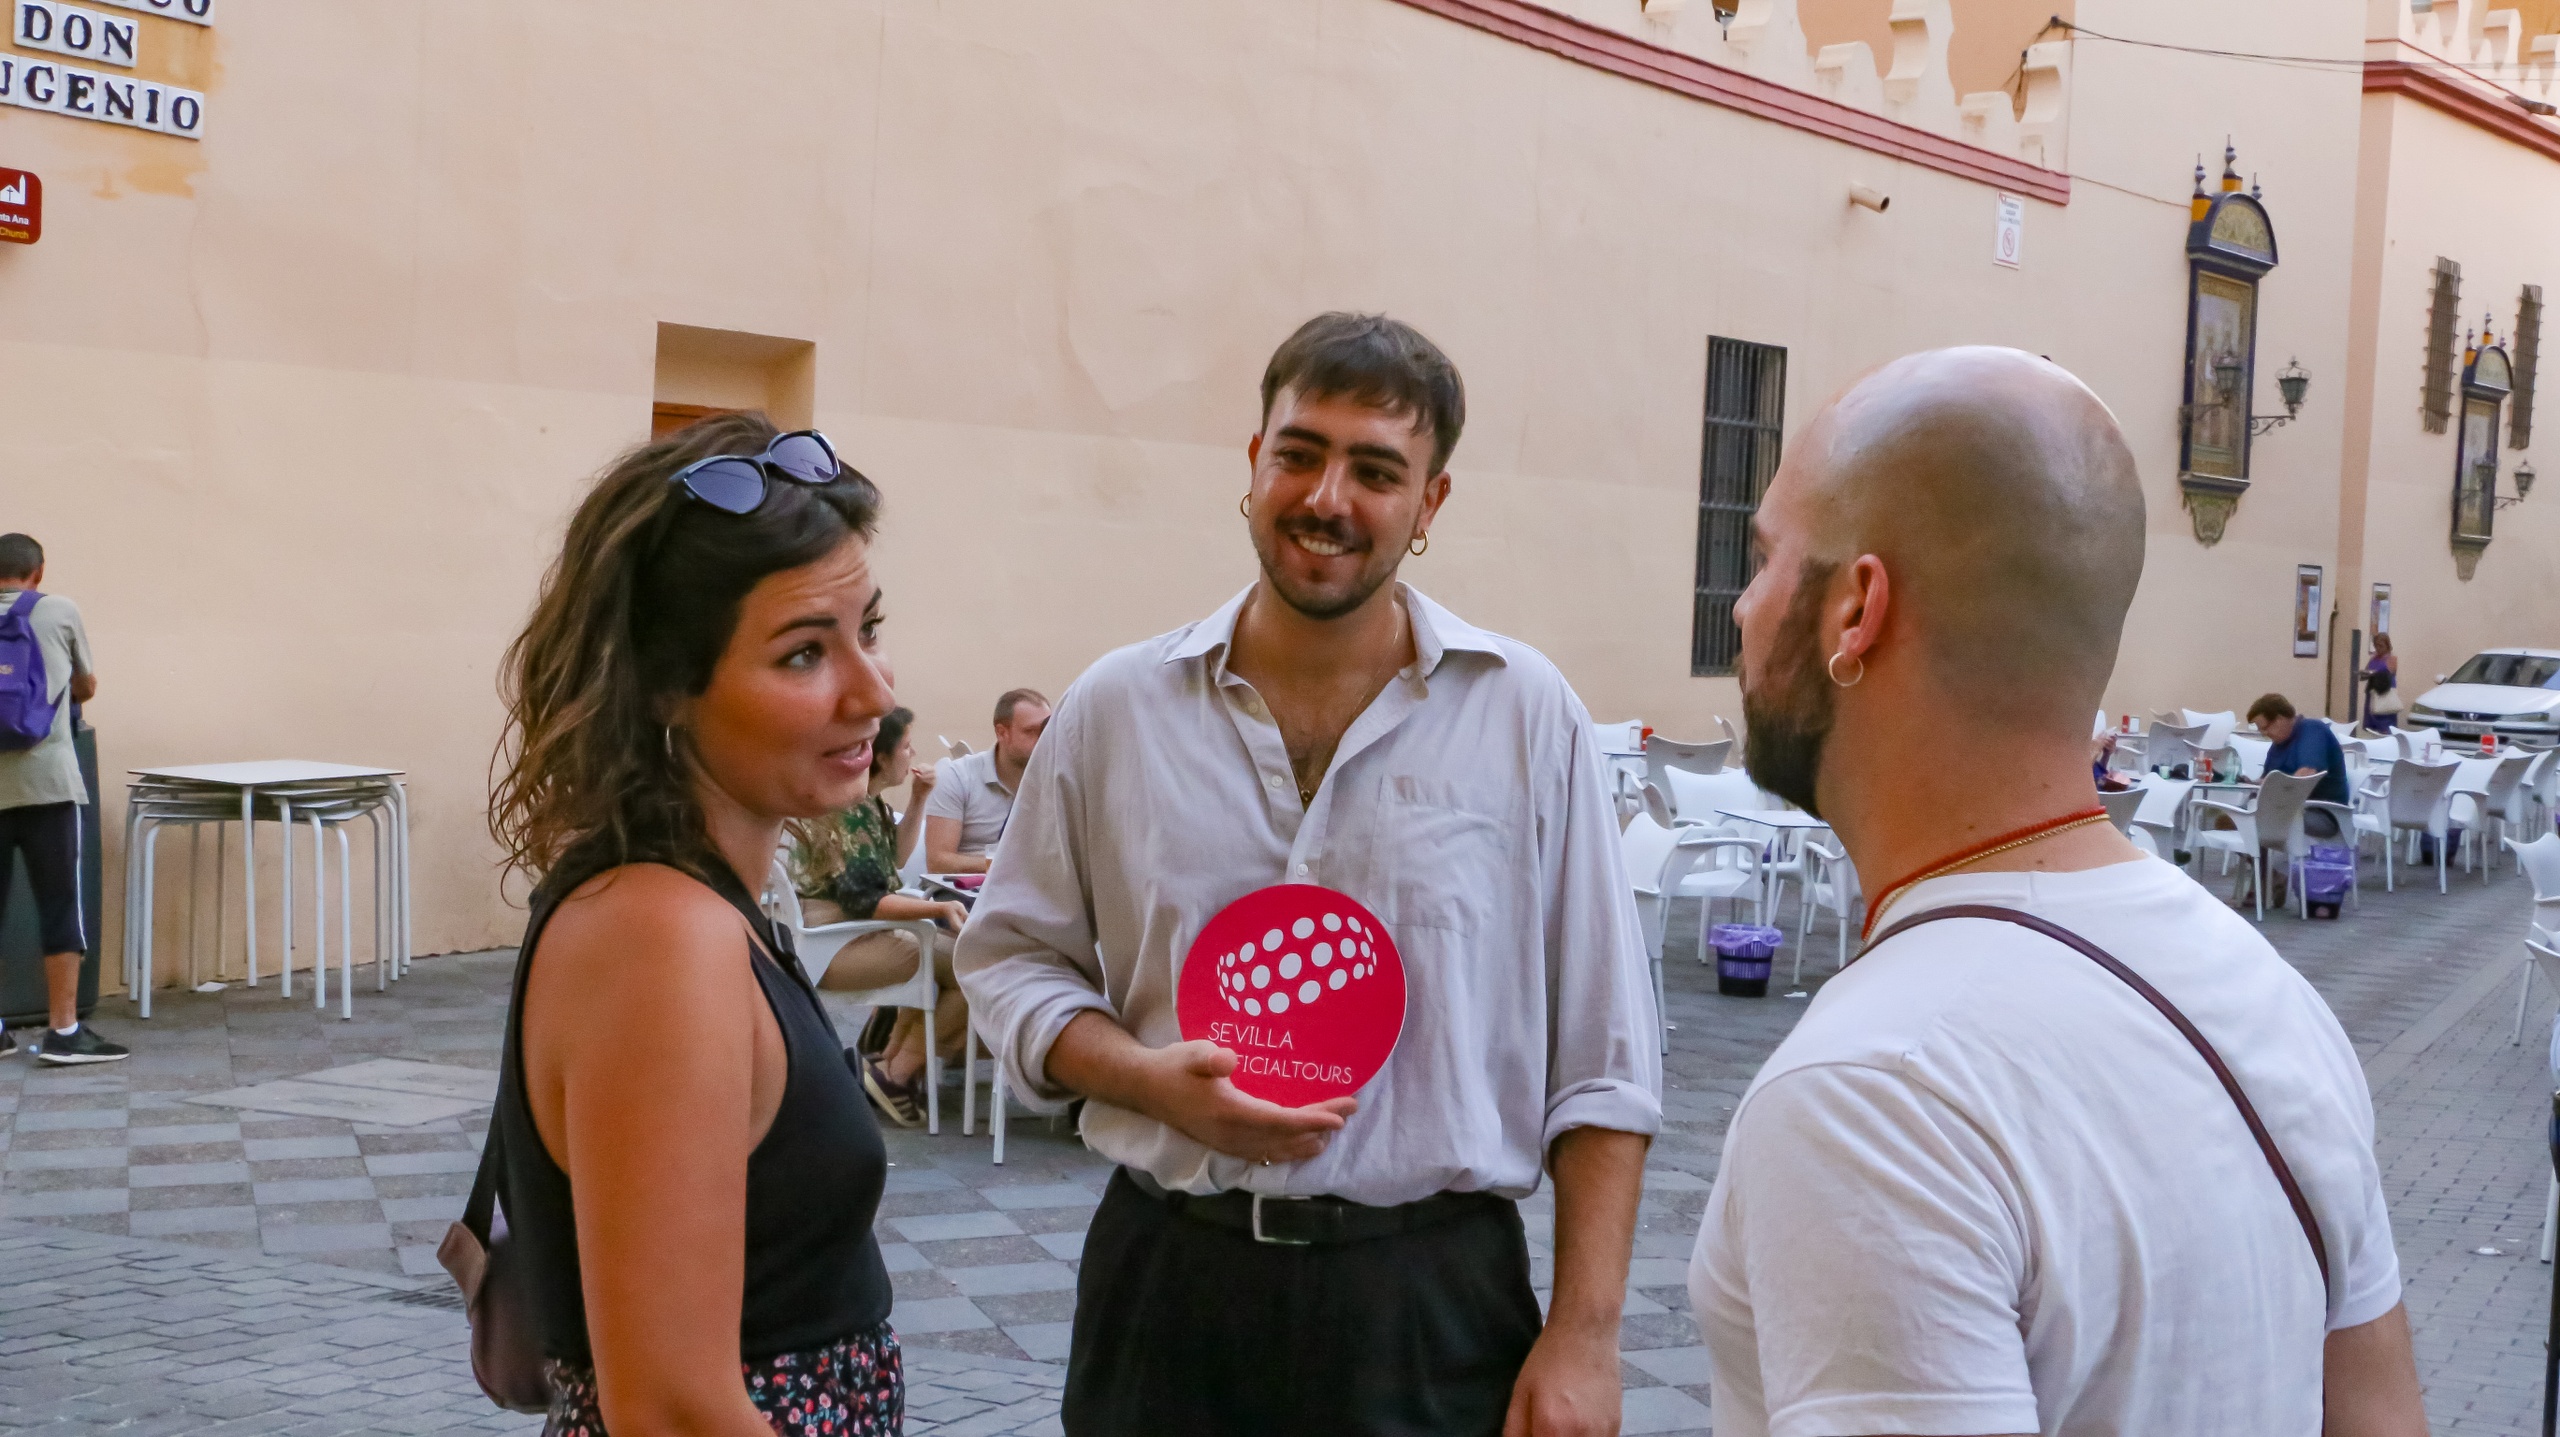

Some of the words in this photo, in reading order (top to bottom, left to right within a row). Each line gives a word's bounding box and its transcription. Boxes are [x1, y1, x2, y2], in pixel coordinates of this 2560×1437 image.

[22, 4, 134, 59] DON
[12, 214, 30, 225] Ana
[0, 226, 29, 239] Church
[1207, 1021, 1293, 1050] SEVILLA
